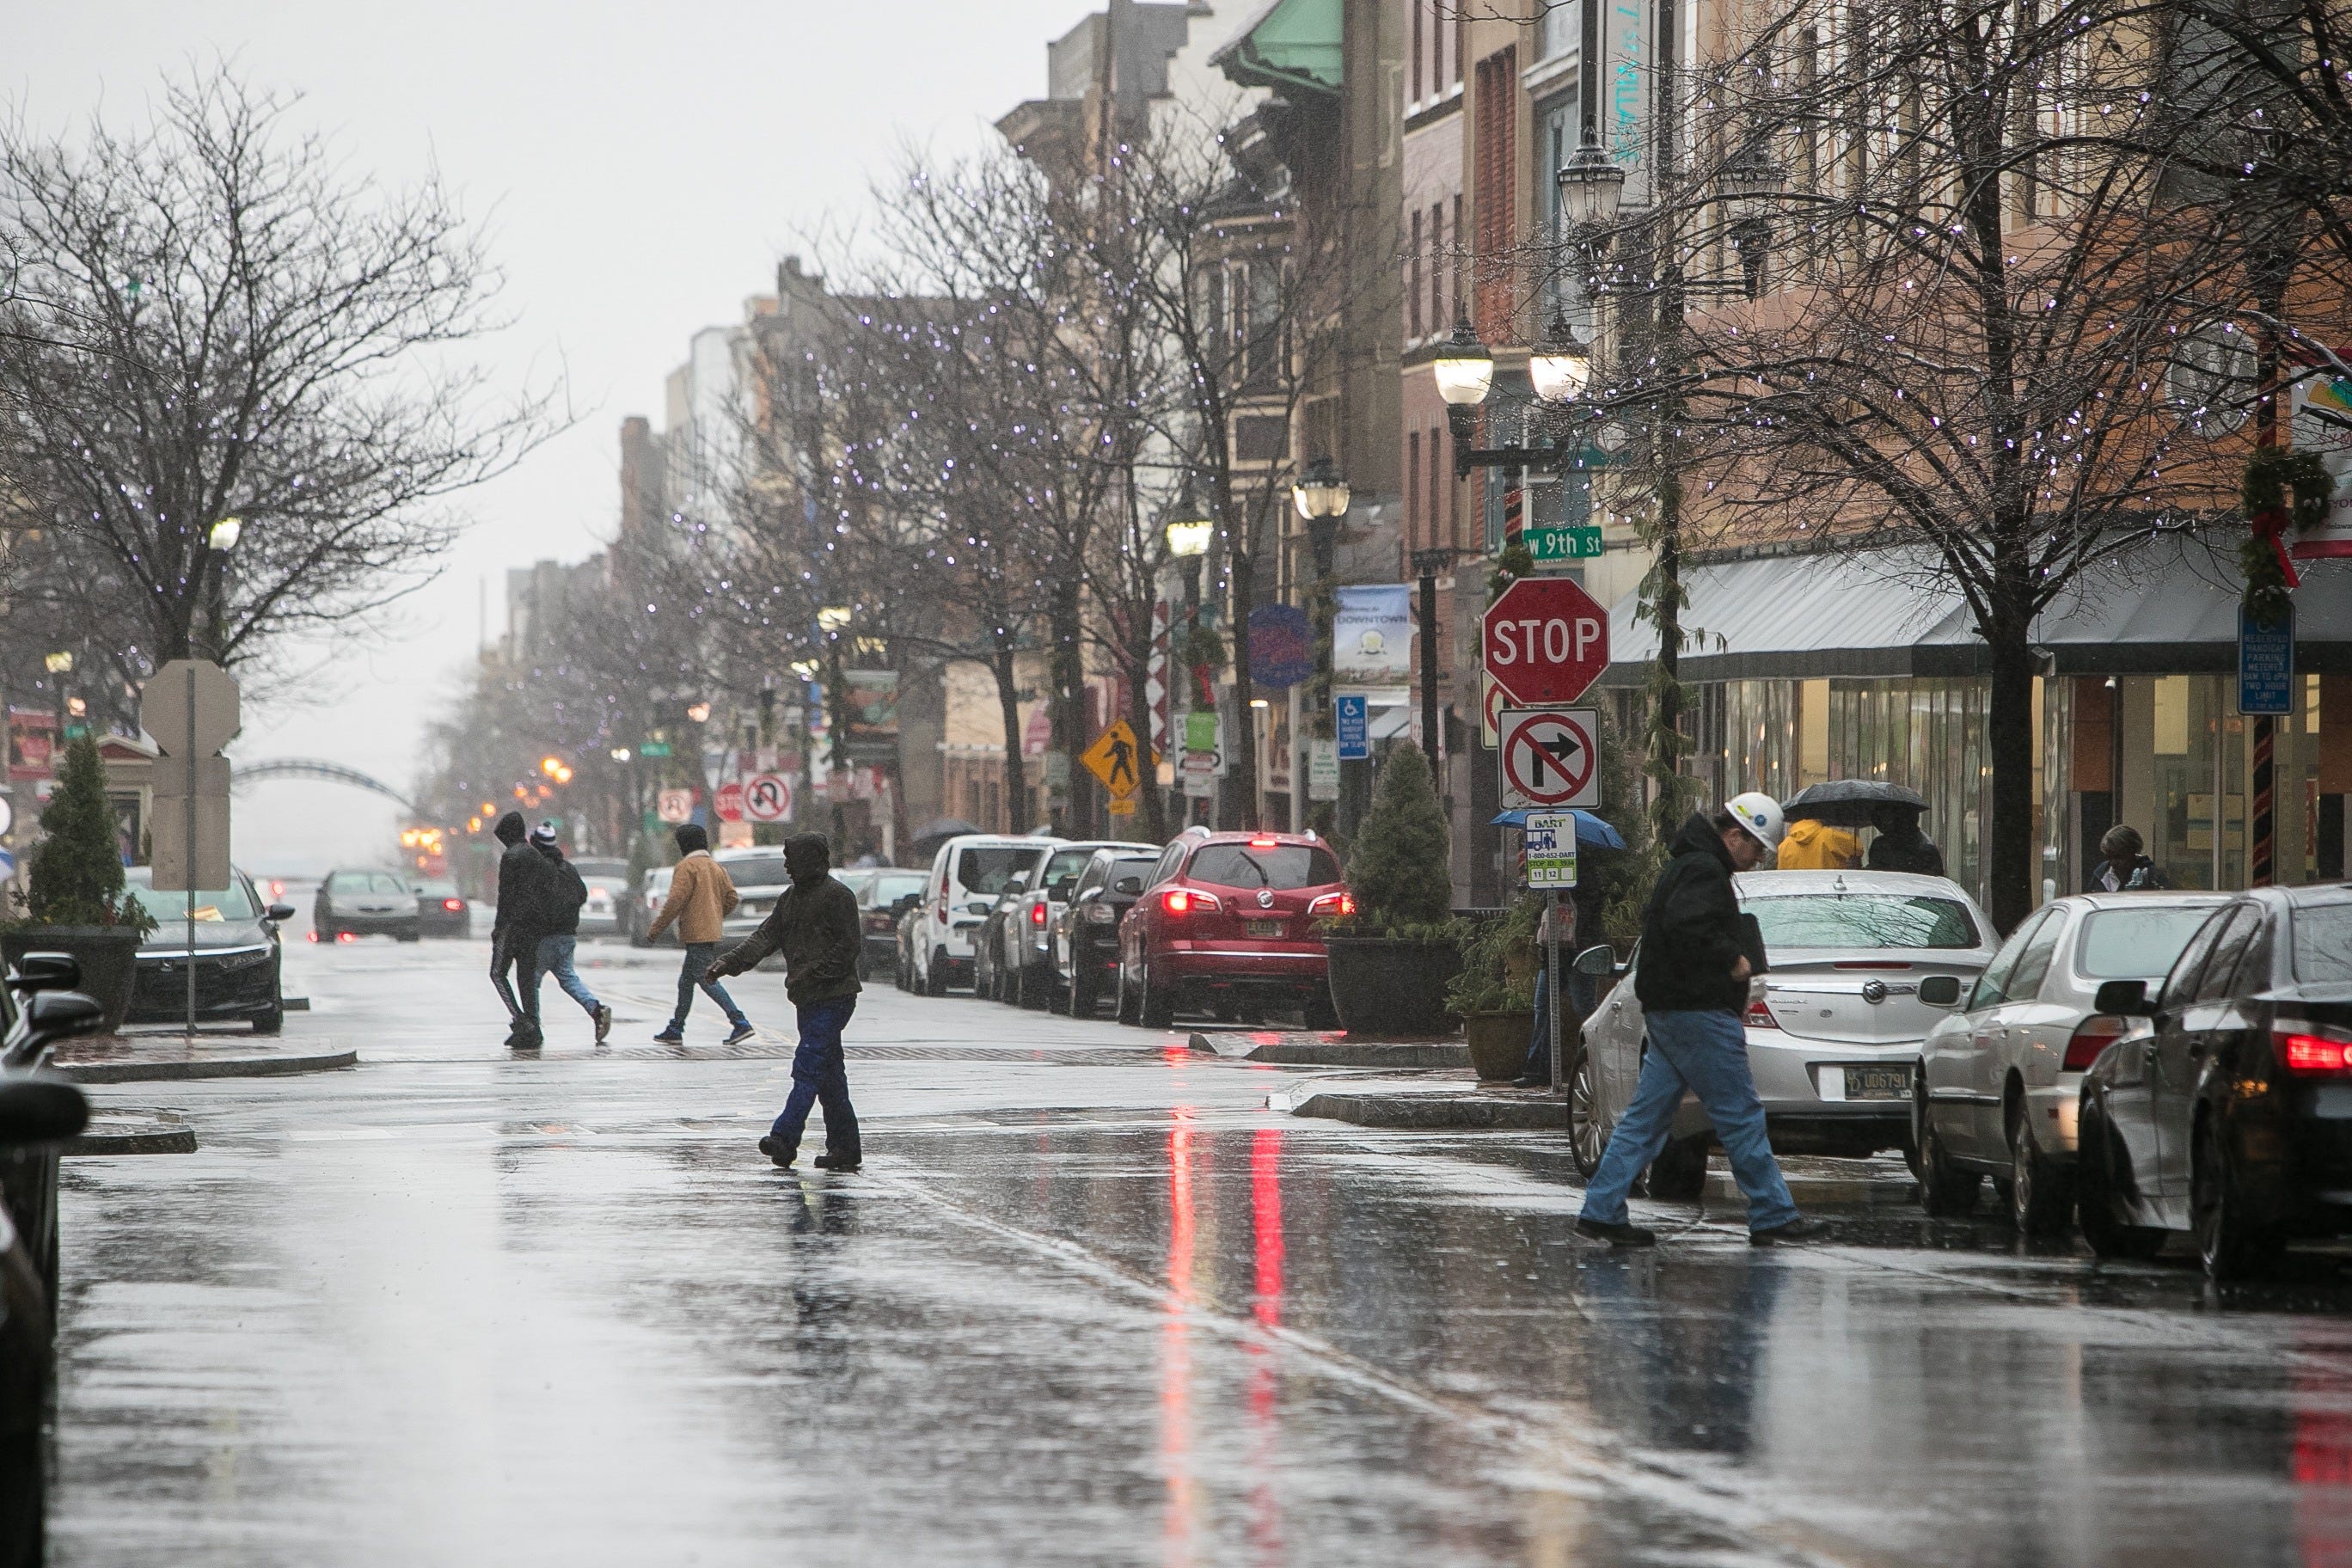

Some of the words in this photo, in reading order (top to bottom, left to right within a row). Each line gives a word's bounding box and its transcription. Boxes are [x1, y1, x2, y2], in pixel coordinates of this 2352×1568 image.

[1528, 539, 1539, 555] W
[1546, 533, 1577, 554] 9th
[1586, 536, 1601, 553] St
[1493, 618, 1600, 665] STOP
[2245, 634, 2288, 643] RESERVED
[2246, 644, 2286, 652] HANDICAP
[2245, 682, 2261, 690] TWO
[2255, 691, 2275, 700] LIMIT
[1534, 818, 1565, 828] DART
